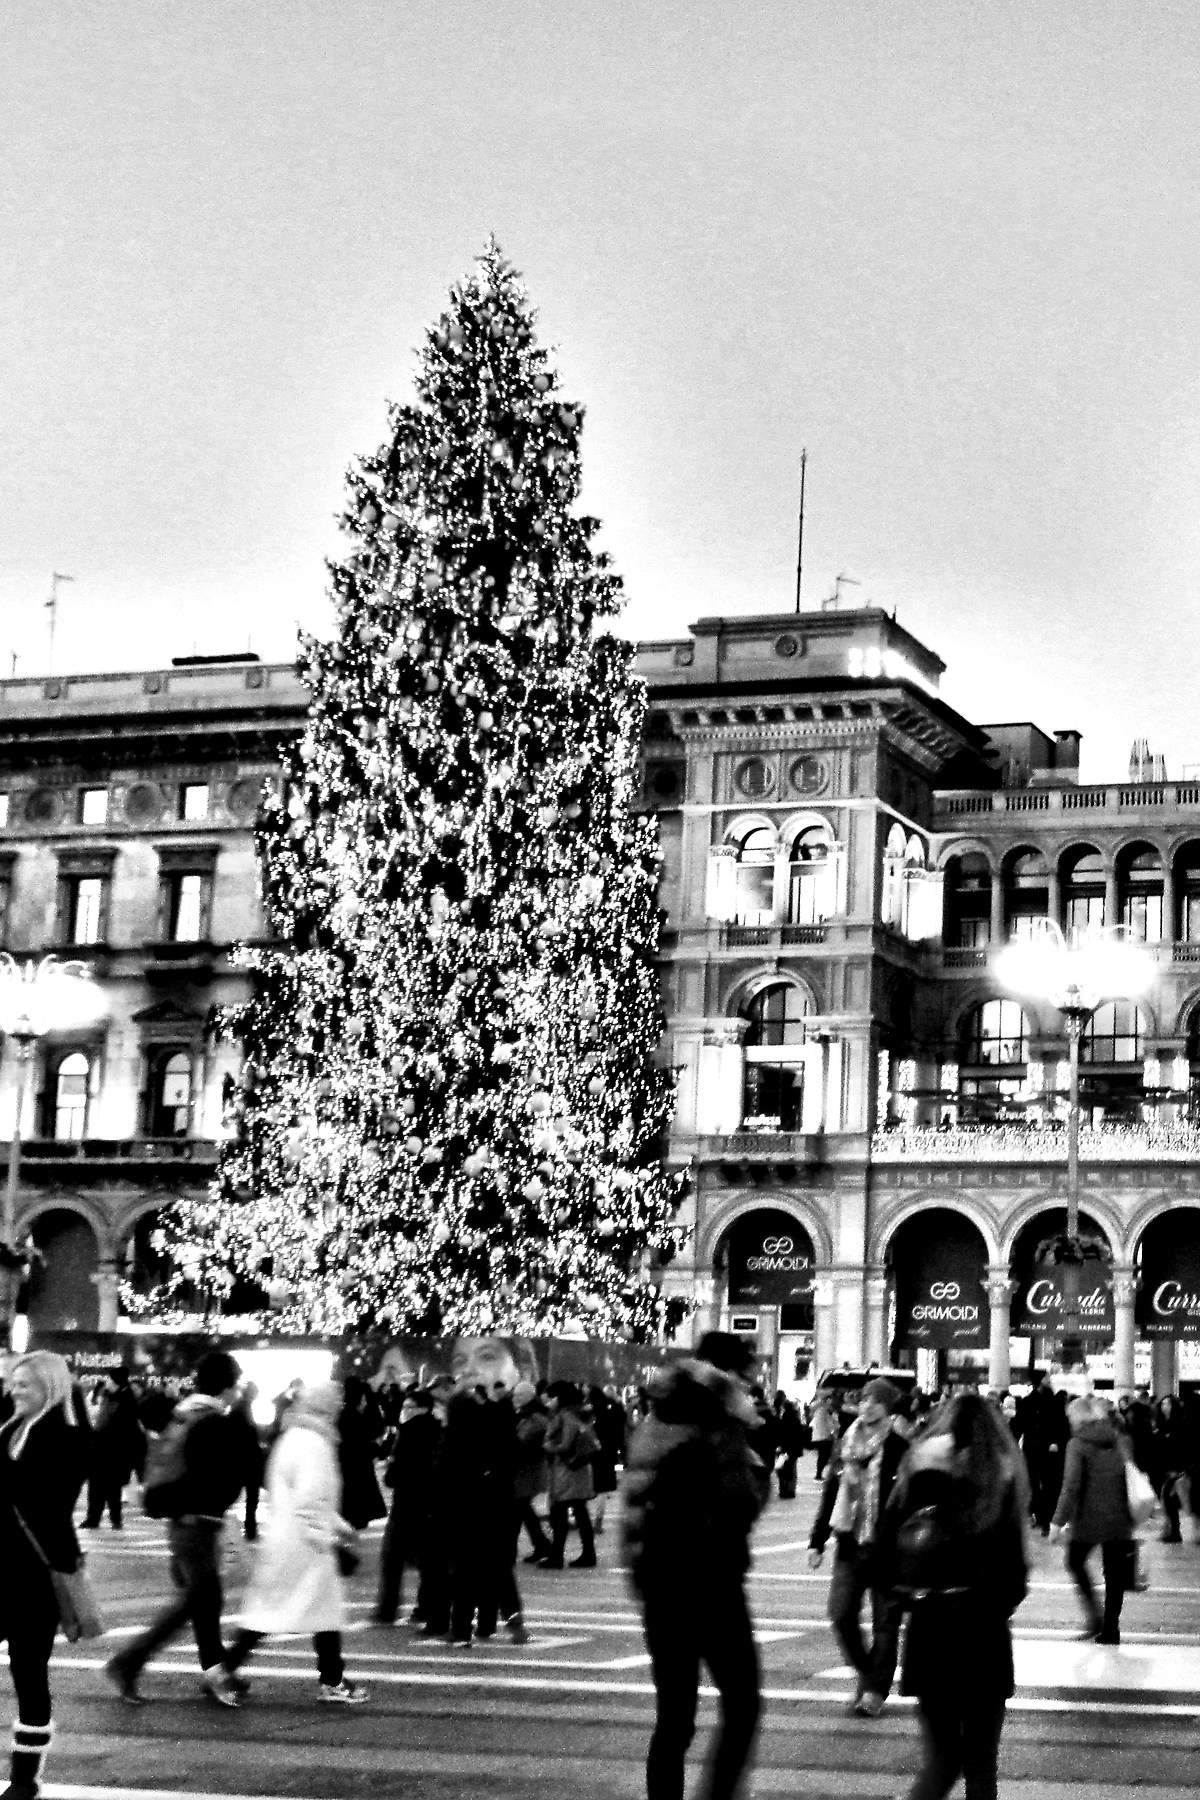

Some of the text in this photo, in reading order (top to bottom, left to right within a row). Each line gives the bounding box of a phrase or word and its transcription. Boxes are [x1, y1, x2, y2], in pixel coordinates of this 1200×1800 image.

[746, 1255, 809, 1271] GRIMOLDI
[1026, 1279, 1106, 1314] Curdo
[912, 1305, 979, 1320] GRIMOLDI
